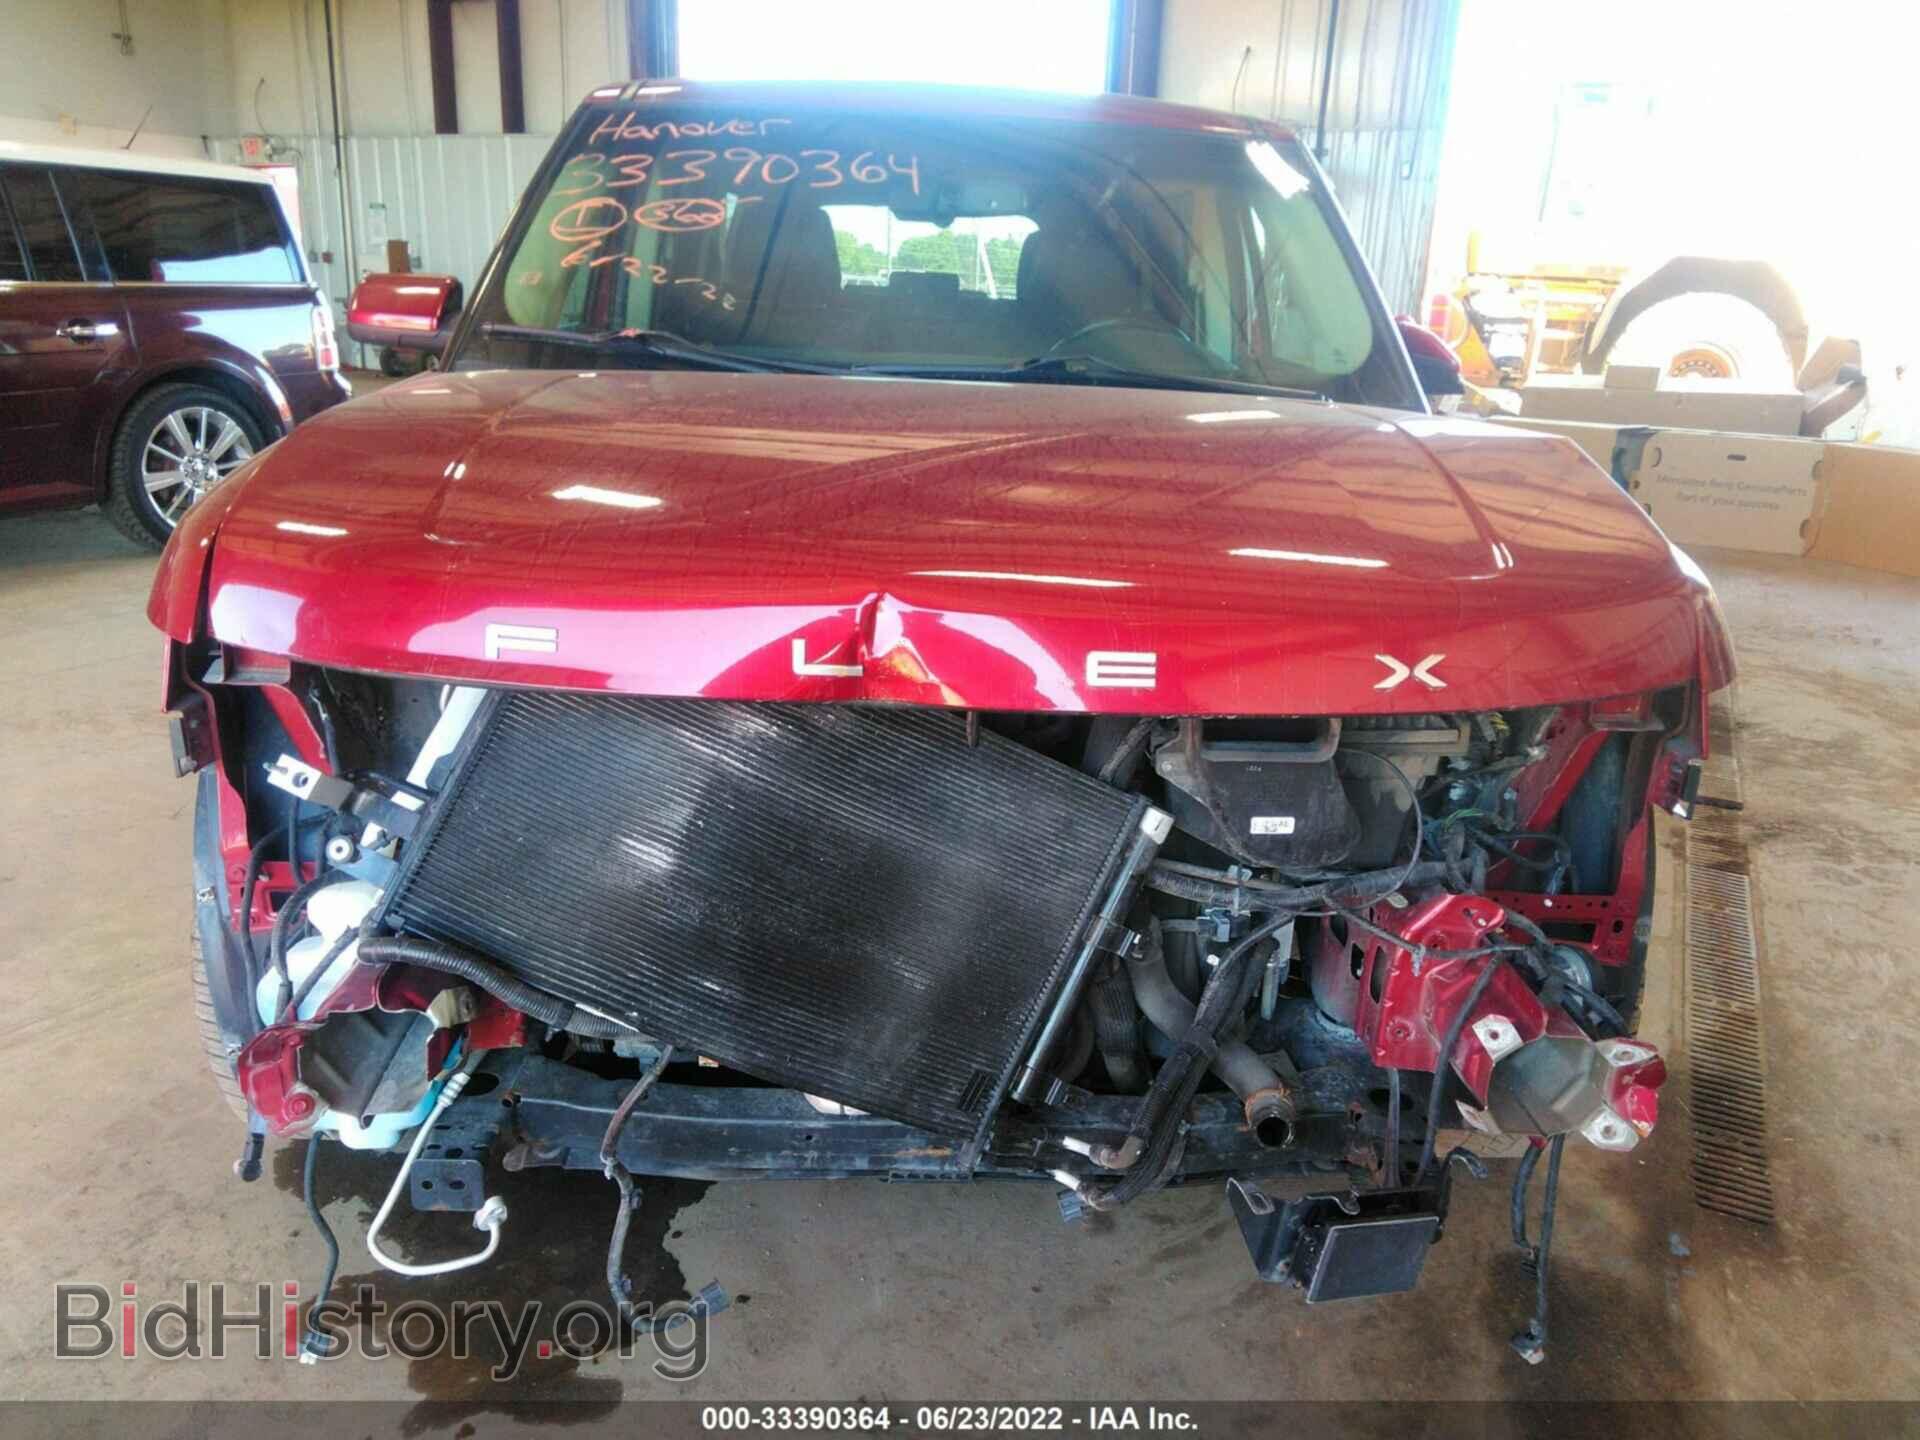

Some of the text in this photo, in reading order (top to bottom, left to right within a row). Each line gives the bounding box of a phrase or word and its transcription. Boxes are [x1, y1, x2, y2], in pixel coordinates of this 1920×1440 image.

[590, 112, 791, 143] Hanover
[553, 148, 920, 195] 33390364
[485, 624, 1448, 690] FLEX
